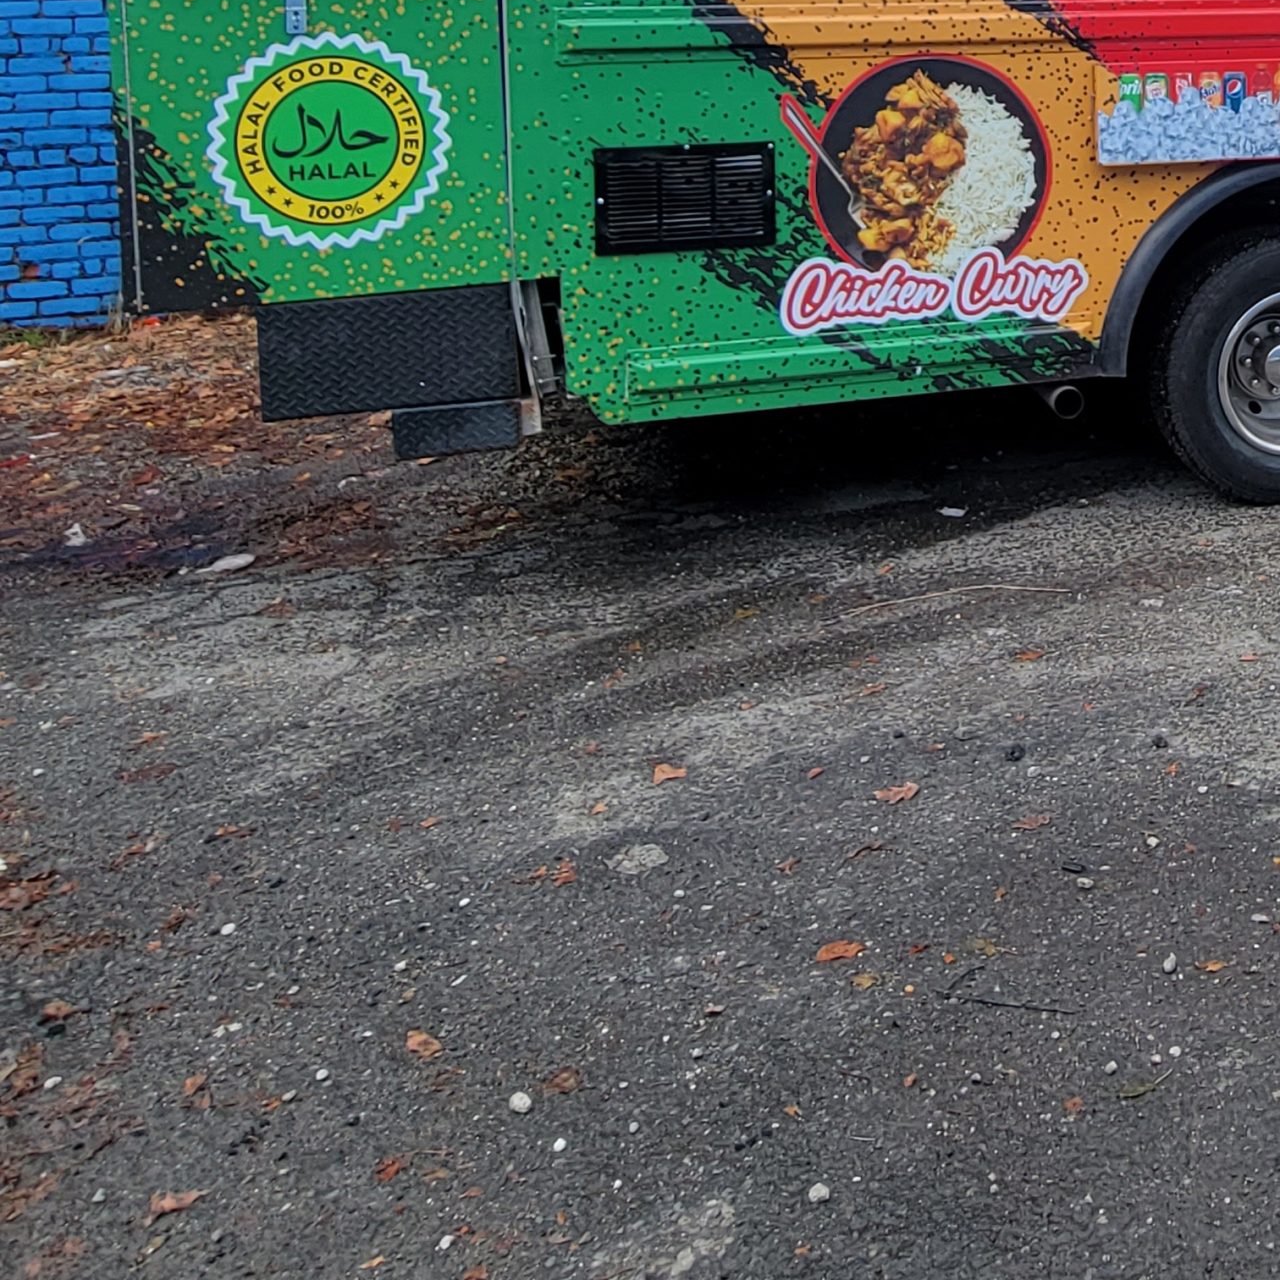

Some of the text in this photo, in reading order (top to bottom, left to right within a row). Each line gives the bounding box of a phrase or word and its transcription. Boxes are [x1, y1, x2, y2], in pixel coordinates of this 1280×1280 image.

[241, 61, 419, 175] HALAL FOOD CERTIFIED
[272, 103, 390, 158] حلال
[289, 161, 377, 182] HALAL
[306, 201, 364, 220] 100%
[789, 253, 1081, 329] Chicken Curry
